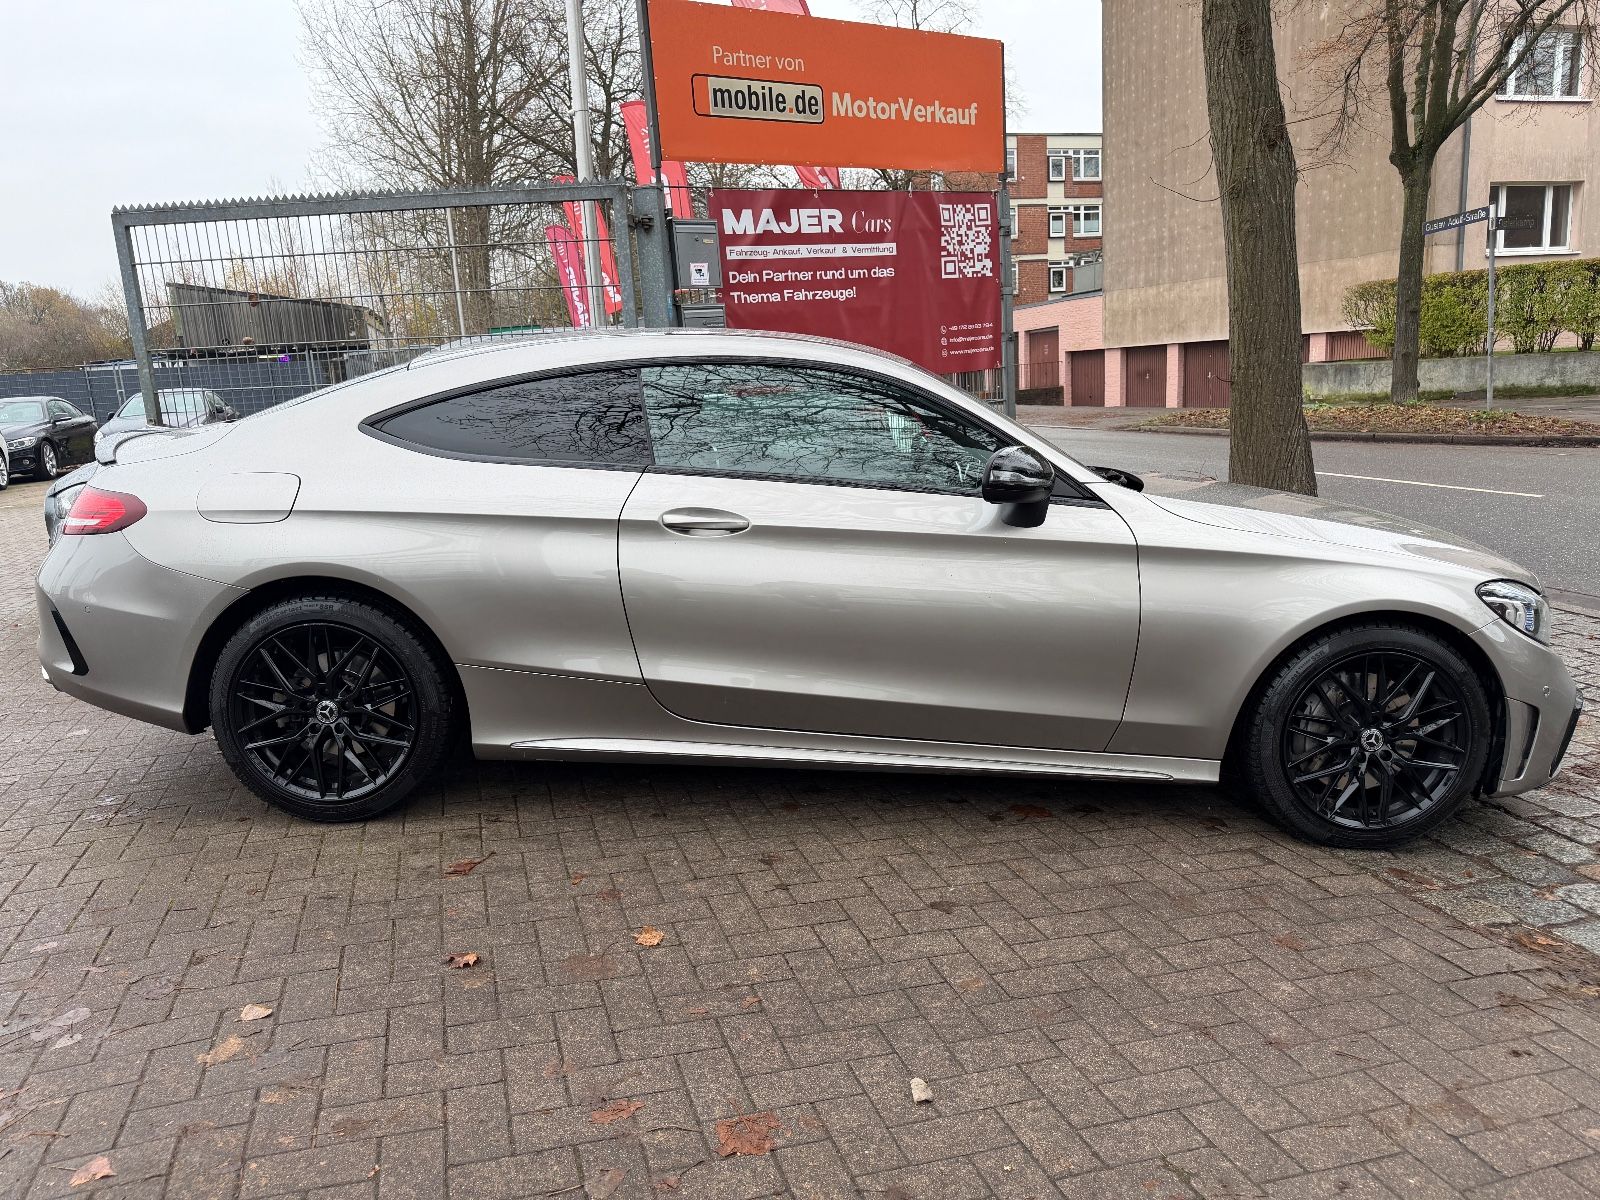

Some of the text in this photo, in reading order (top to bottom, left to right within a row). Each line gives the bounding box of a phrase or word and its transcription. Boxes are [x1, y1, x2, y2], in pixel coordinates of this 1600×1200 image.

[712, 45, 805, 72] Partner von
[712, 84, 978, 125] mobile.de MotorVerkauf
[721, 208, 892, 235] MAJER Cars
[806, 246, 837, 256] Verkauf
[842, 246, 848, 255] &
[851, 244, 894, 256] Vermittlung
[729, 265, 895, 284] Dein Partner rund um das
[730, 286, 857, 304] Thema Fahrzeuge!
